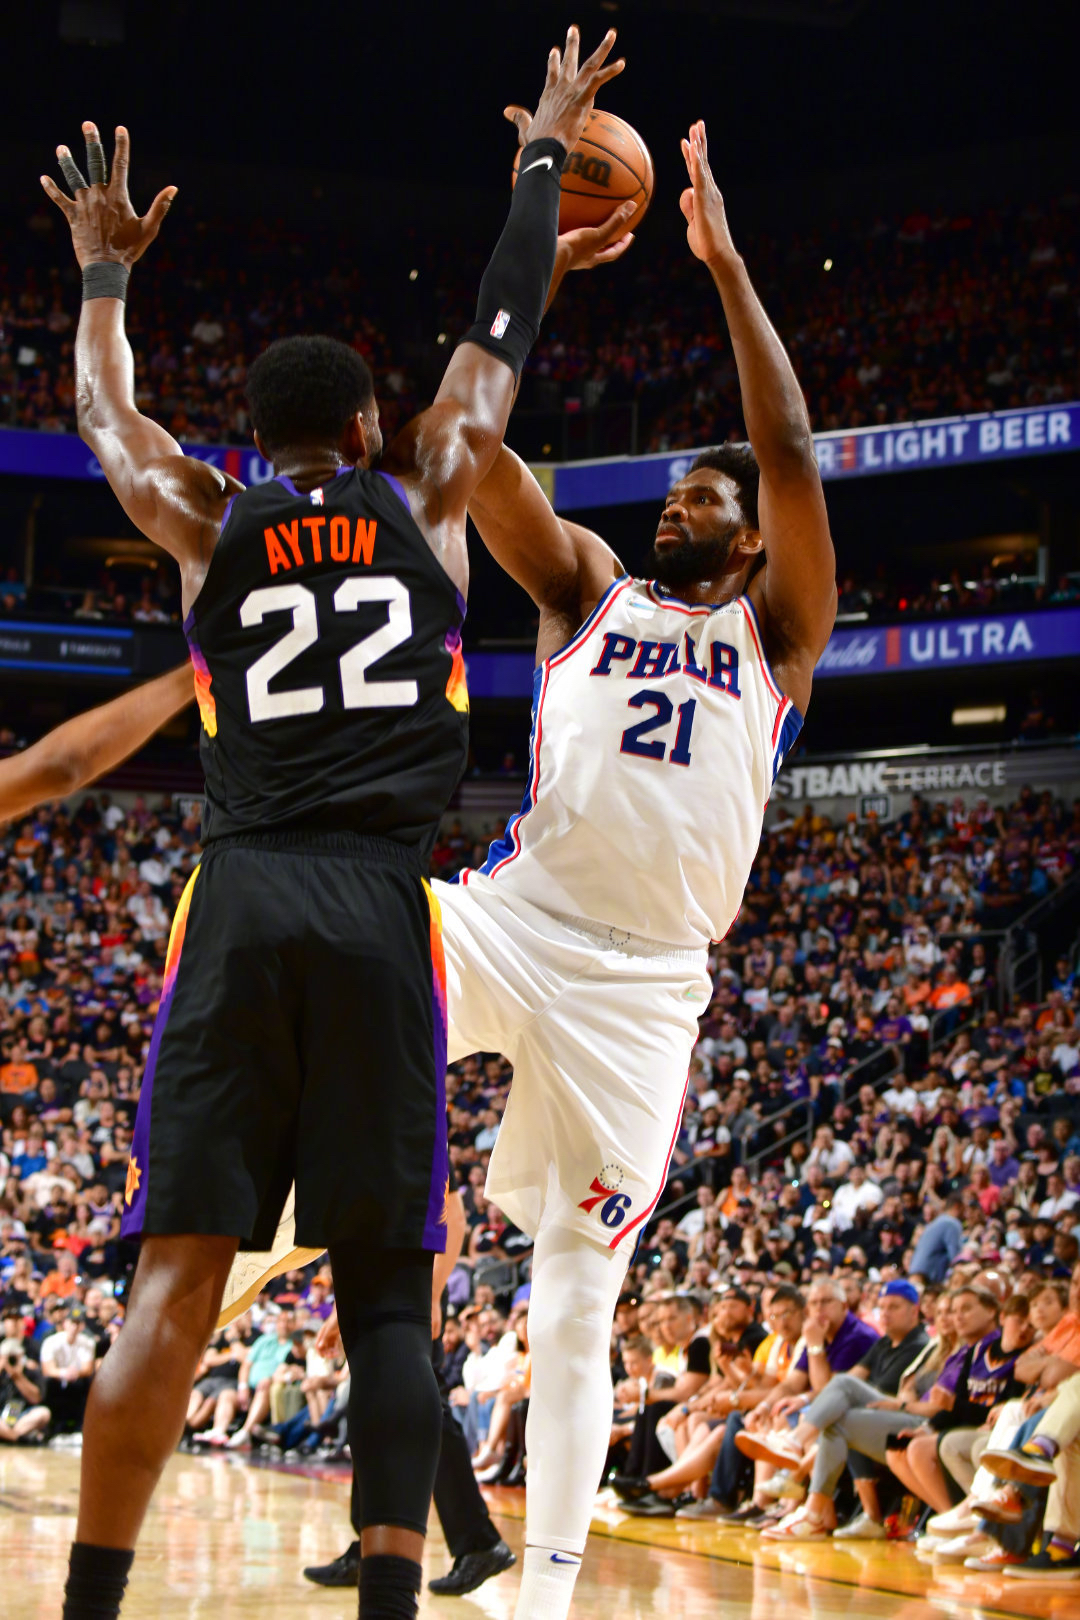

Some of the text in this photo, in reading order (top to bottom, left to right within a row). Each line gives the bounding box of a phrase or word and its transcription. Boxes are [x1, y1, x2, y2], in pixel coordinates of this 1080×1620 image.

[863, 422, 970, 467] LIGHT
[979, 411, 1071, 454] BEER
[263, 515, 378, 575] AYTON
[239, 575, 419, 723] 22
[589, 630, 742, 700] PHILA
[909, 618, 1034, 662] ULTRA
[619, 689, 697, 767] 21
[898, 761, 1007, 791] TERRACE
[577, 1176, 632, 1228] 76
